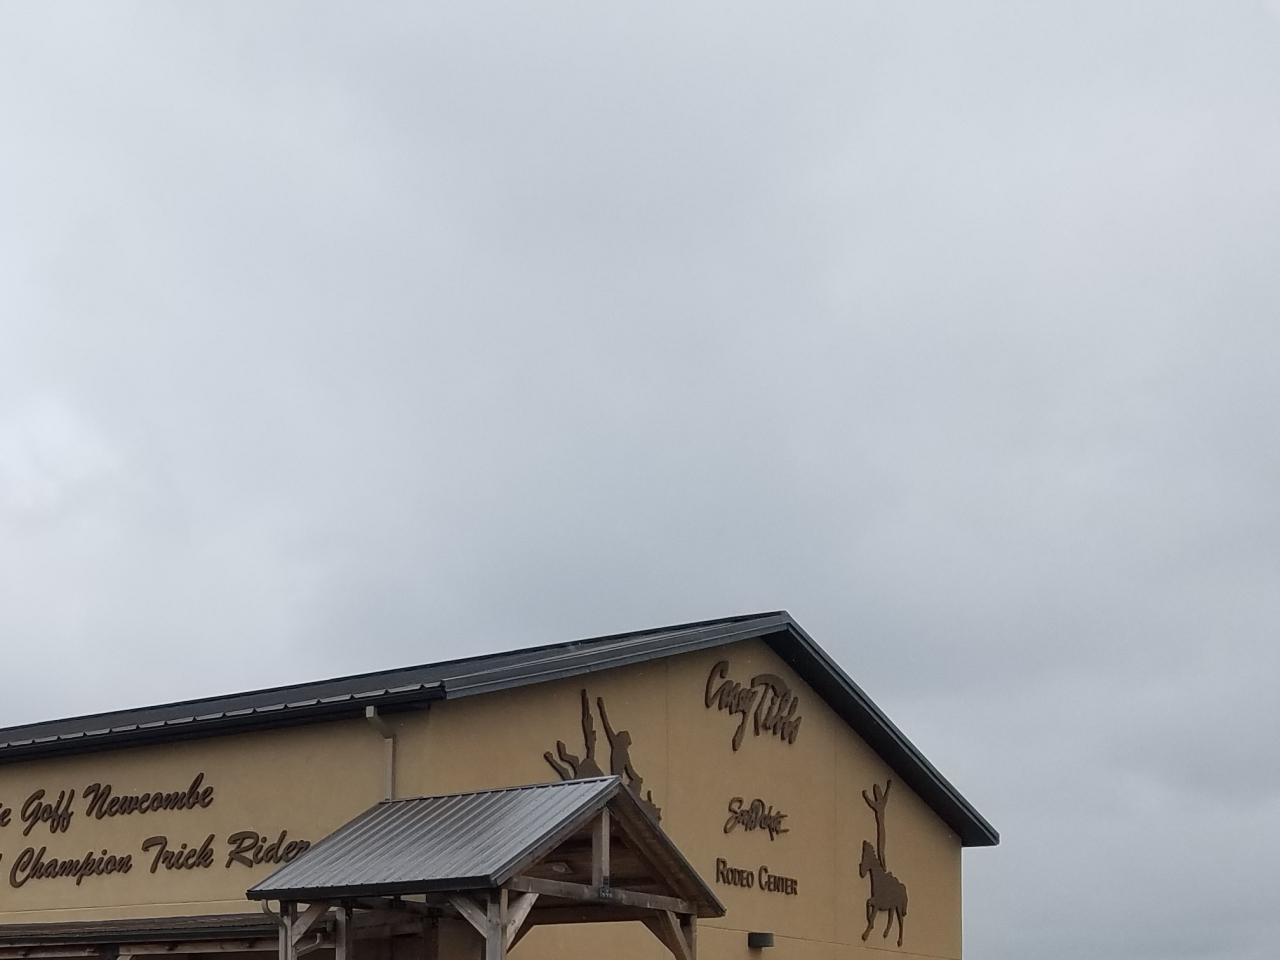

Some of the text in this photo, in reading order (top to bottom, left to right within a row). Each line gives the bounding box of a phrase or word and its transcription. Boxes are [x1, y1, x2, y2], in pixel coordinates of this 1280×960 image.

[21, 789, 75, 836] Goff
[82, 772, 214, 820] Newcombe
[9, 847, 133, 888] Champion
[142, 834, 216, 874] Trick
[225, 830, 311, 869] Rider
